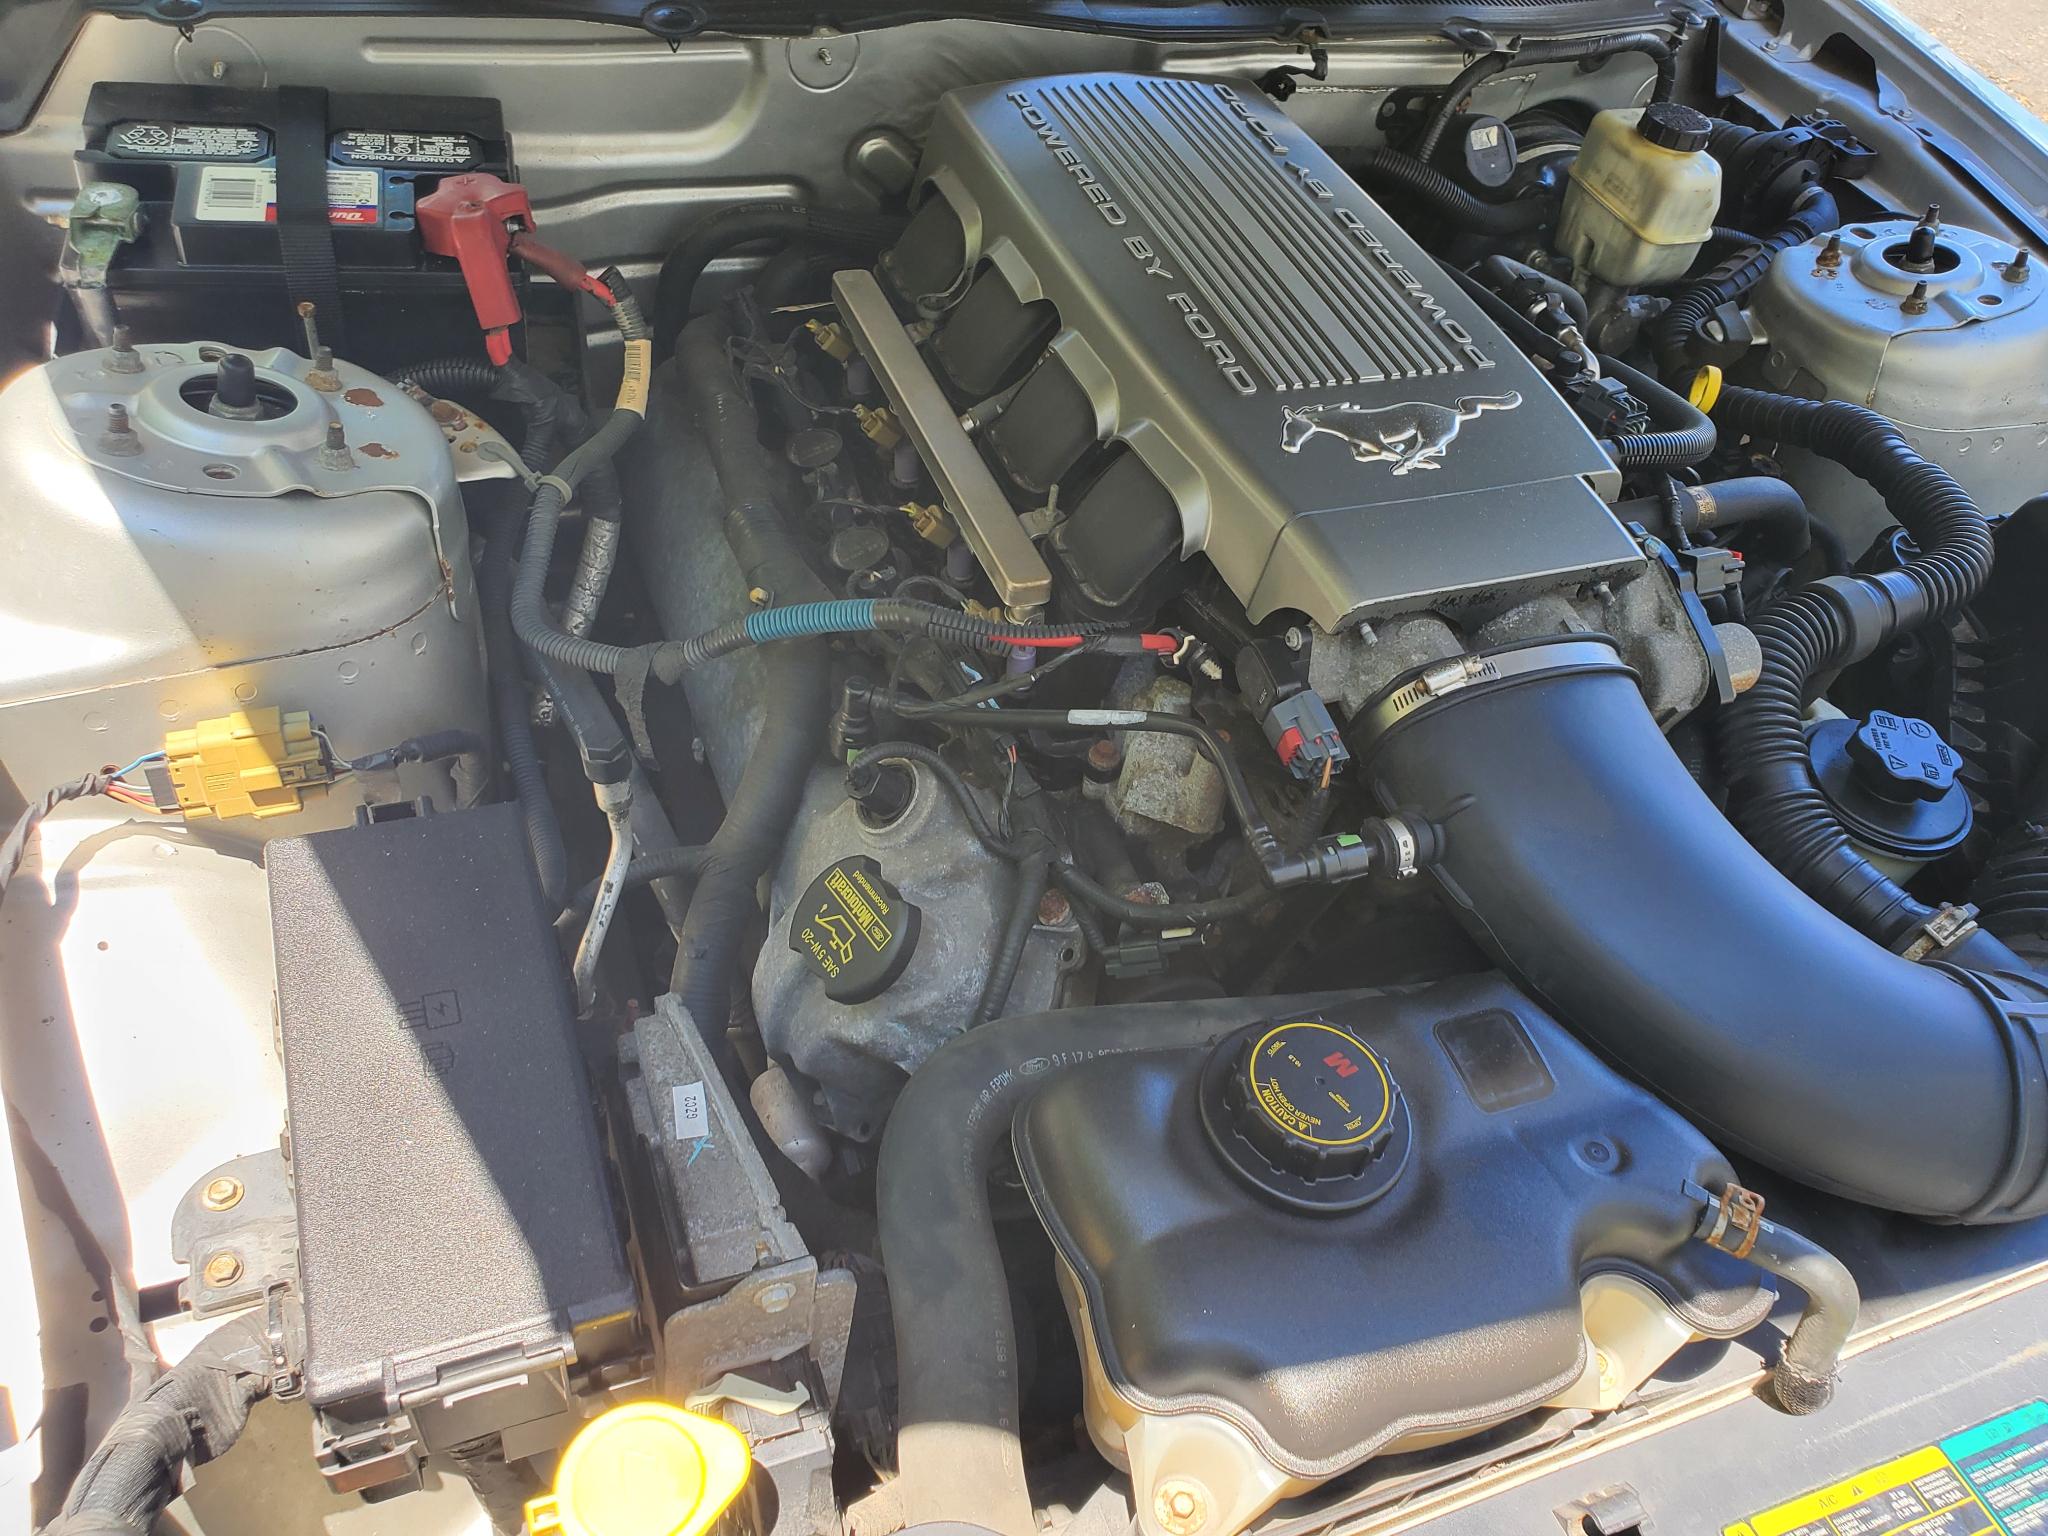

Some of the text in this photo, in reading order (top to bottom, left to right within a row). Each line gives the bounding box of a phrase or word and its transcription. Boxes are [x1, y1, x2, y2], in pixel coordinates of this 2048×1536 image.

[407, 155, 454, 163] DANGER
[1007, 90, 1257, 393] POWERED BY FORD
[1213, 83, 1496, 368] POWERED BY FORD
[829, 871, 875, 929] Motorcraft
[852, 870, 890, 915] Recommended
[801, 928, 840, 978] SAE 5W-20
[1261, 1088, 1296, 1125] CAUTION
[1270, 1077, 1321, 1126] NEVER OPEN HOT
